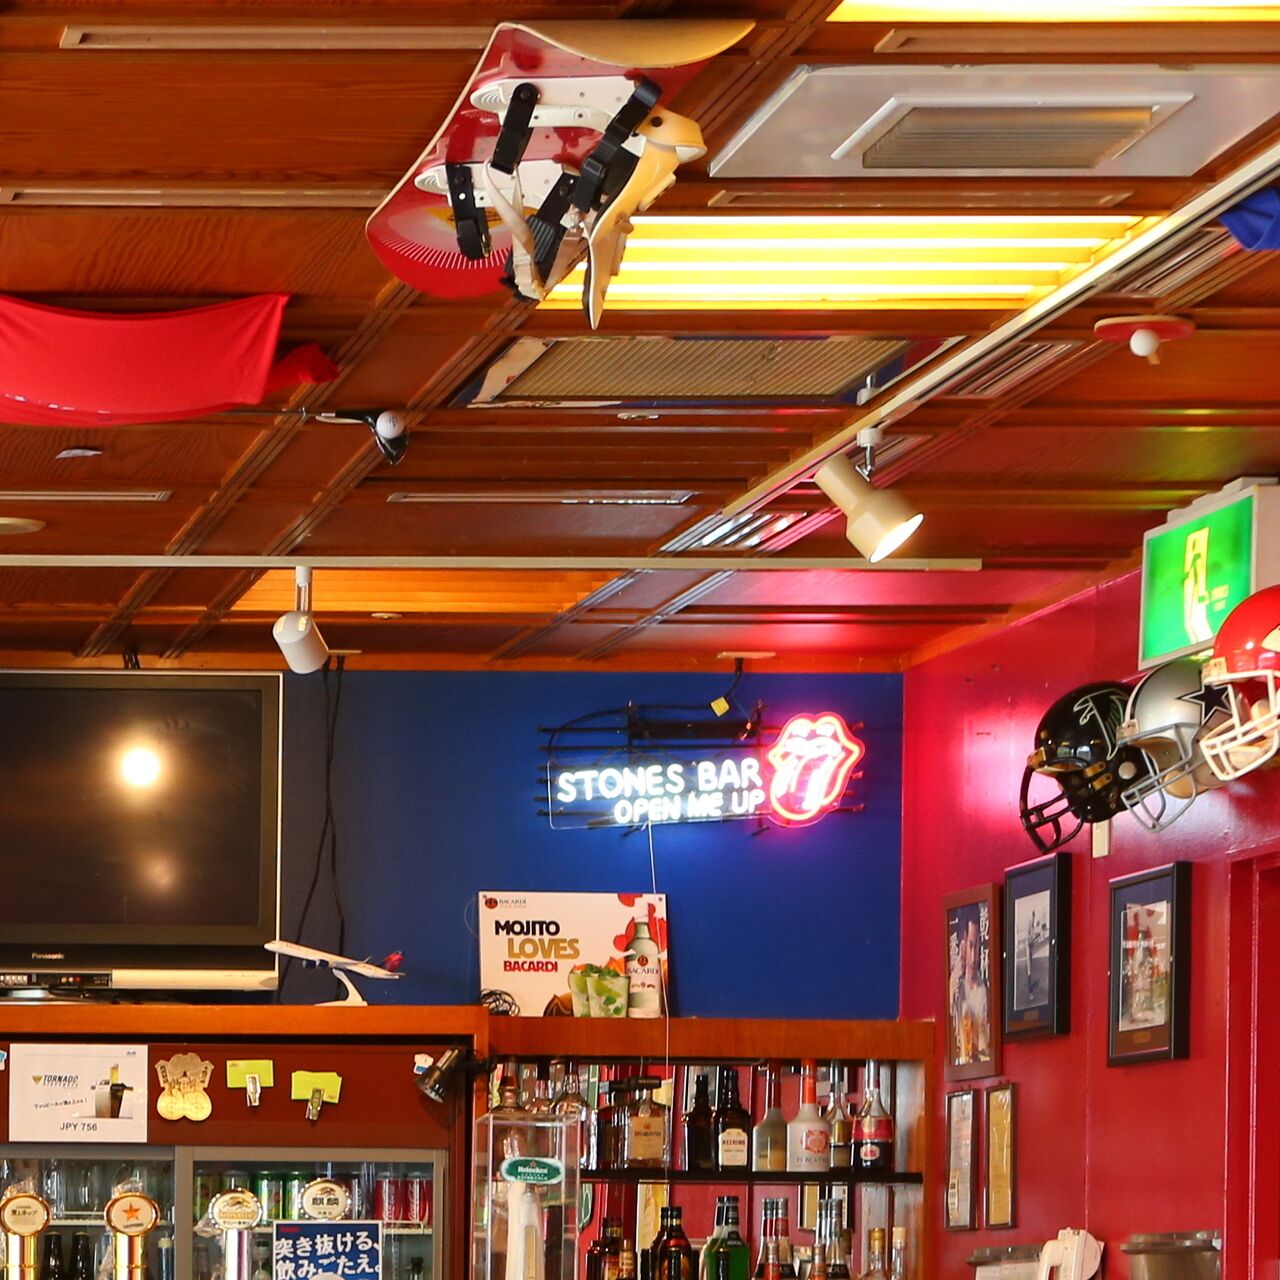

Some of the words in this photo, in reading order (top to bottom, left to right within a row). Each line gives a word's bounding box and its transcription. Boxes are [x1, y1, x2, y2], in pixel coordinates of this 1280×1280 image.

[557, 764, 685, 802] STONES
[697, 757, 763, 791] BAR
[614, 793, 680, 824] OPEN
[686, 791, 724, 817] ME
[731, 788, 766, 814] UP
[494, 920, 561, 936] MOJITO
[507, 938, 581, 960] LOVES
[503, 960, 559, 973] BACARDI
[60, 1123, 78, 1131] JPY
[81, 1123, 98, 1132] 756
[276, 1231, 381, 1259] 突き抜ける、
